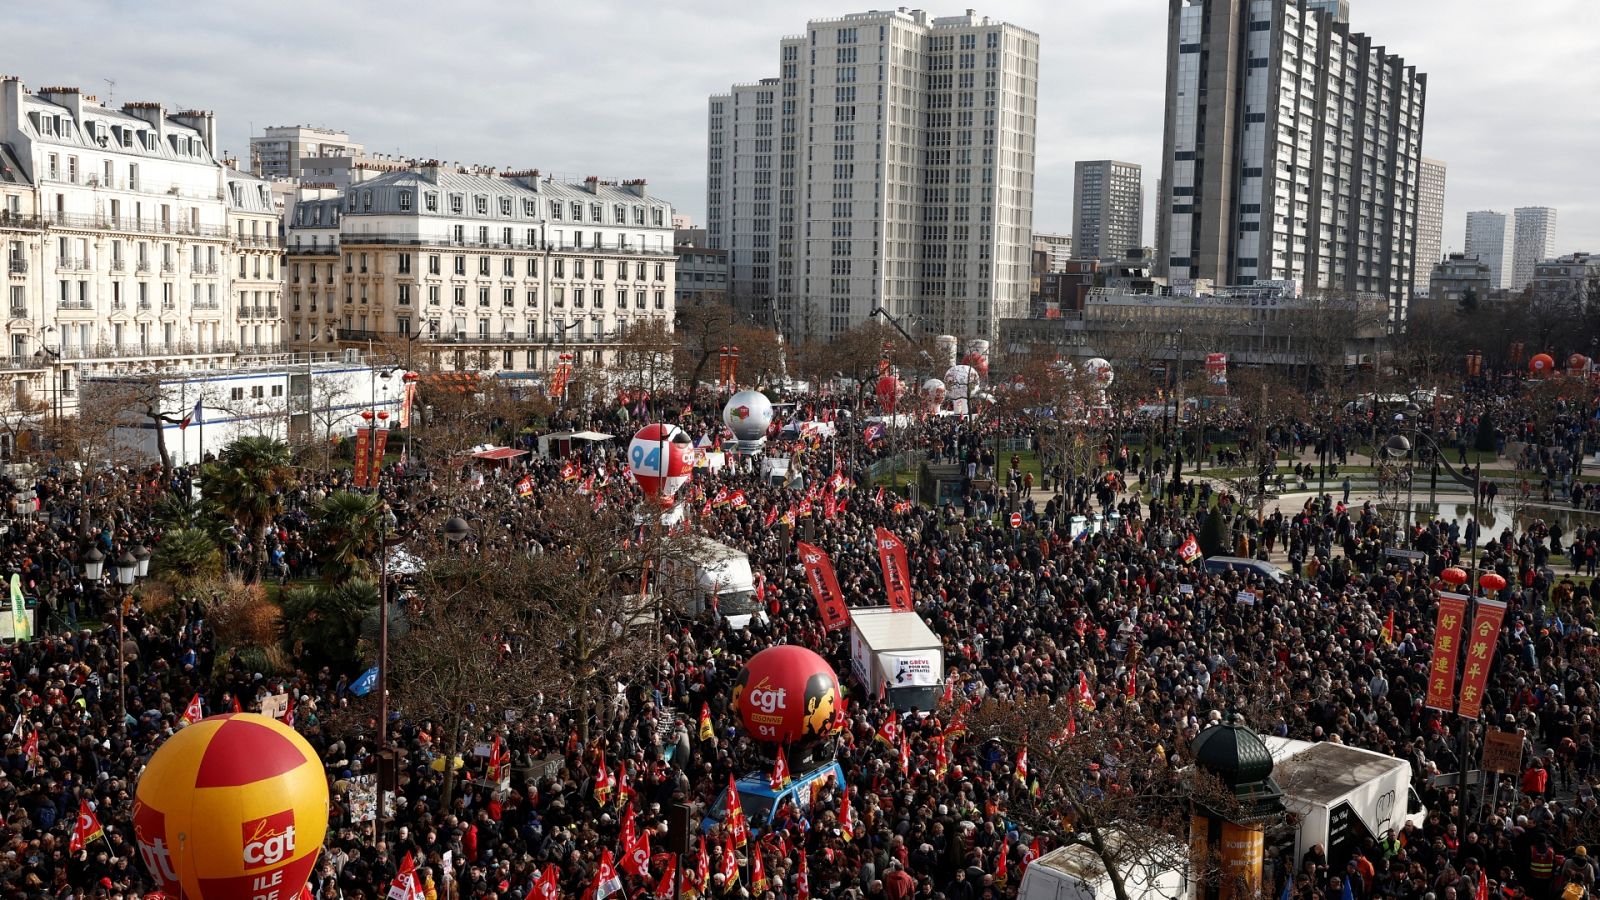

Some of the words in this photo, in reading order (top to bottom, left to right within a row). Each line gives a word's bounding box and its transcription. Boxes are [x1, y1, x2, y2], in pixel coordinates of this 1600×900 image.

[631, 445, 661, 471] 94
[1433, 613, 1457, 695] 好運連年
[1463, 620, 1494, 701] 合境平安
[750, 688, 787, 713] cgt
[758, 725, 776, 737] 91
[139, 837, 178, 886] gt
[243, 825, 296, 865] cgt
[253, 870, 284, 891] ILE
